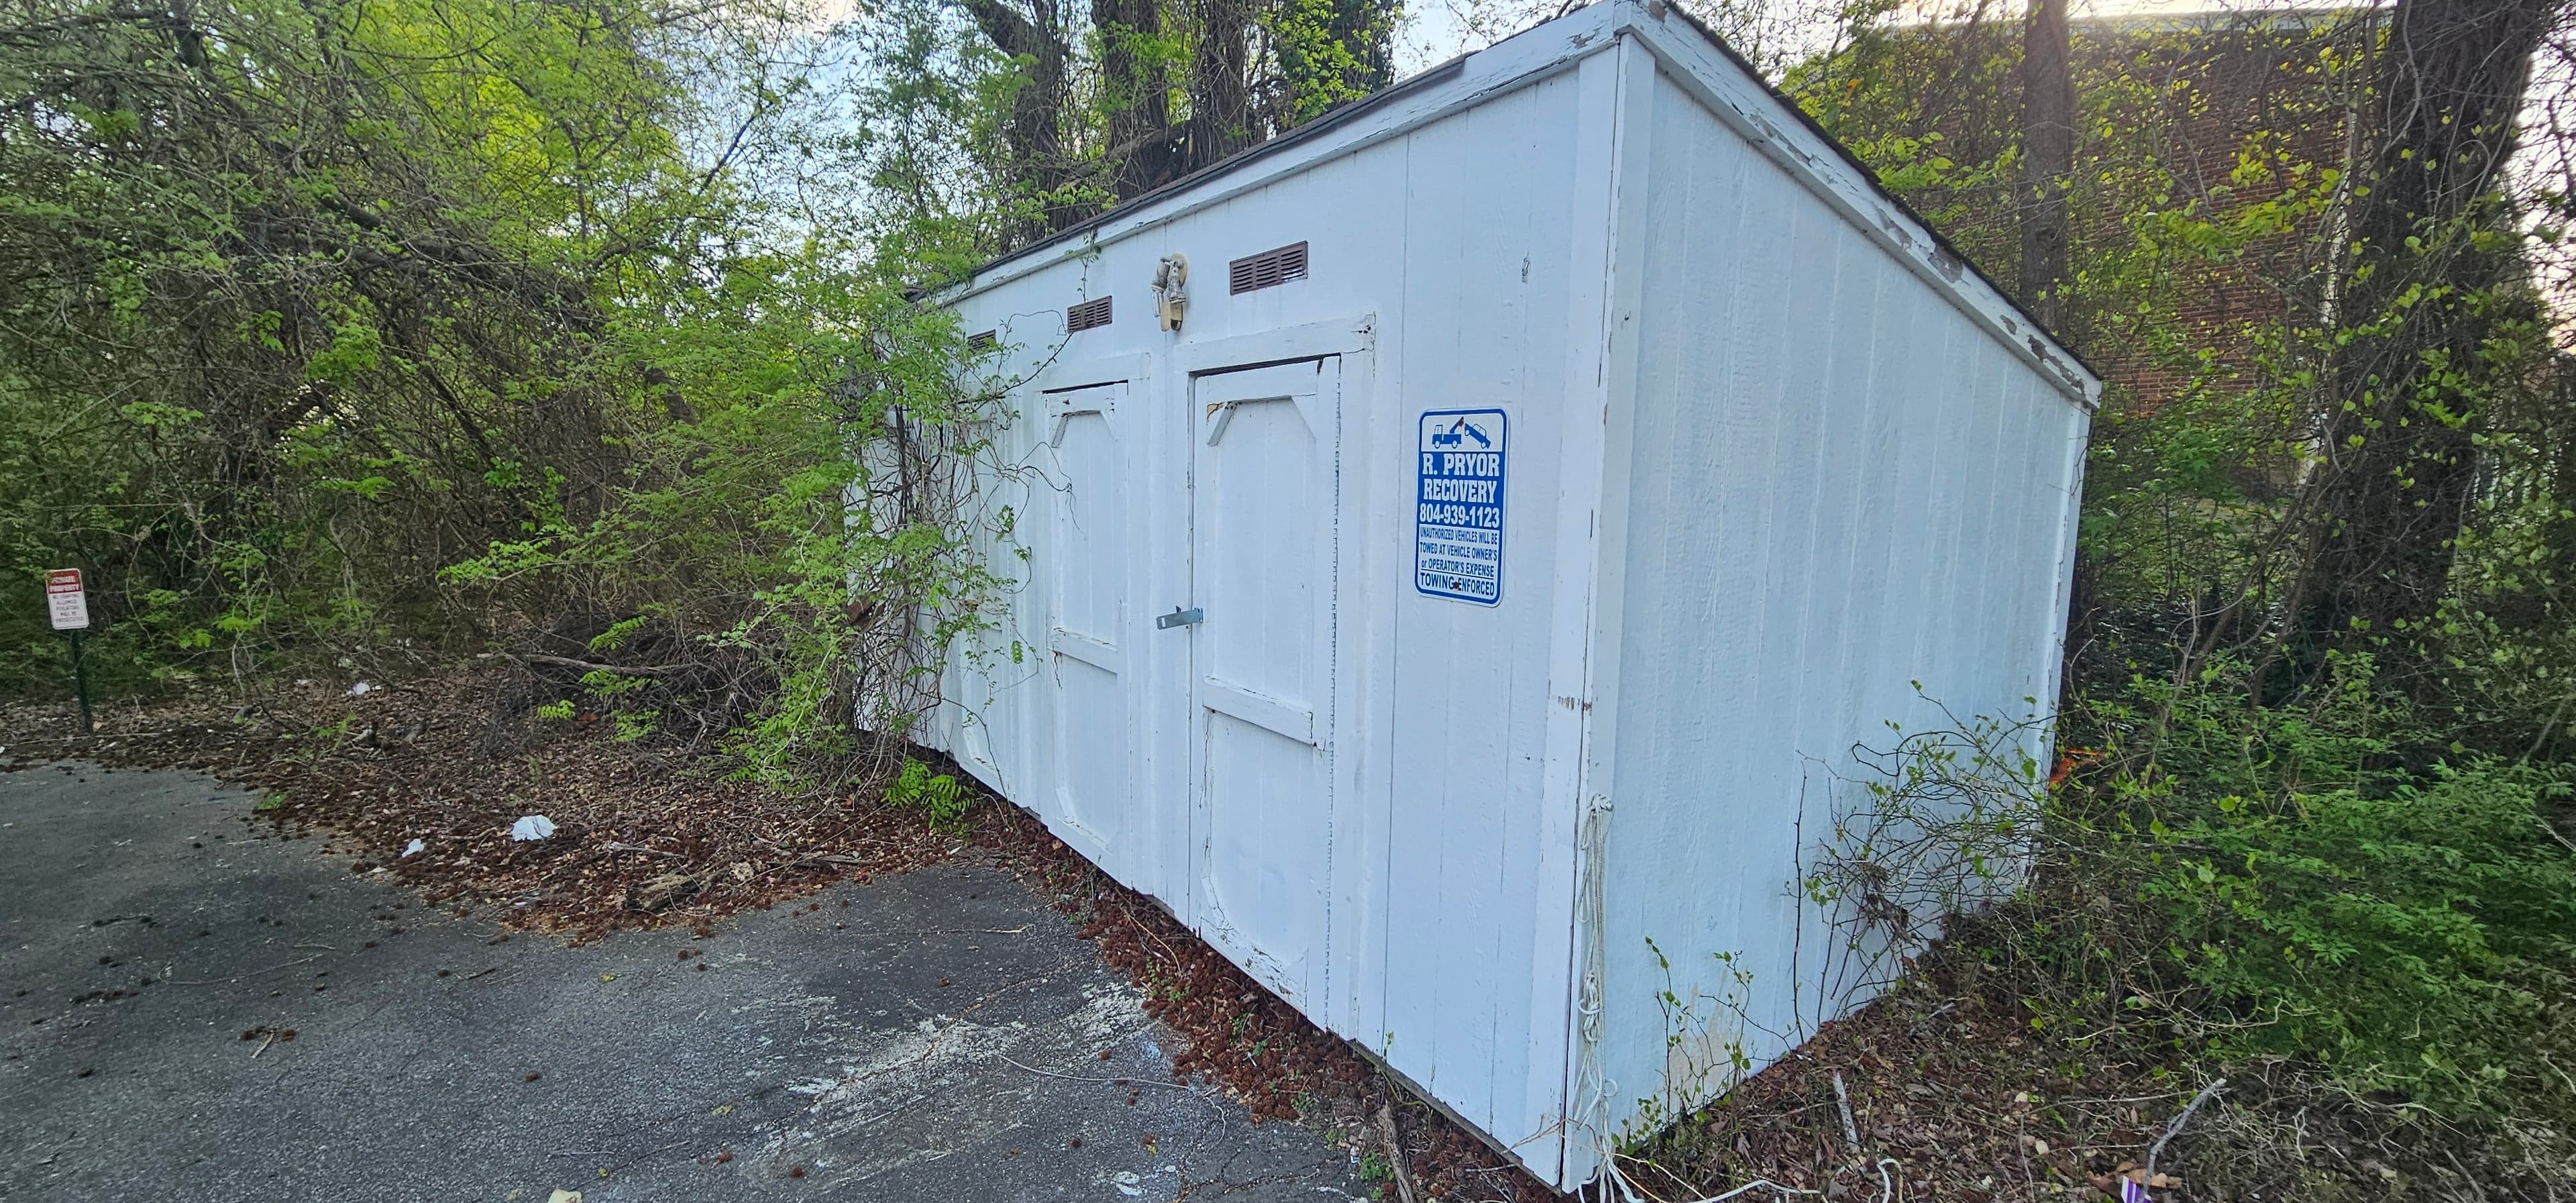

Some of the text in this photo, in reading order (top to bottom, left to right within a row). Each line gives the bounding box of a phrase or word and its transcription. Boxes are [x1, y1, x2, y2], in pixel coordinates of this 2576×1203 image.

[1422, 453, 1500, 477] R. PRYOR
[1423, 478, 1497, 504] RECOVERY
[1419, 503, 1500, 529] 804-939-1123
[1420, 527, 1497, 545] UNAUTHORIZED VEHICLES WILL BE
[1419, 541, 1497, 562] TOWED AT VEHICLE OWNER'S
[1421, 558, 1495, 578] or OPERATOR'S EXPENSE
[49, 584, 80, 592] PROPERTY
[1420, 572, 1495, 596] TOWING ENFORCED
